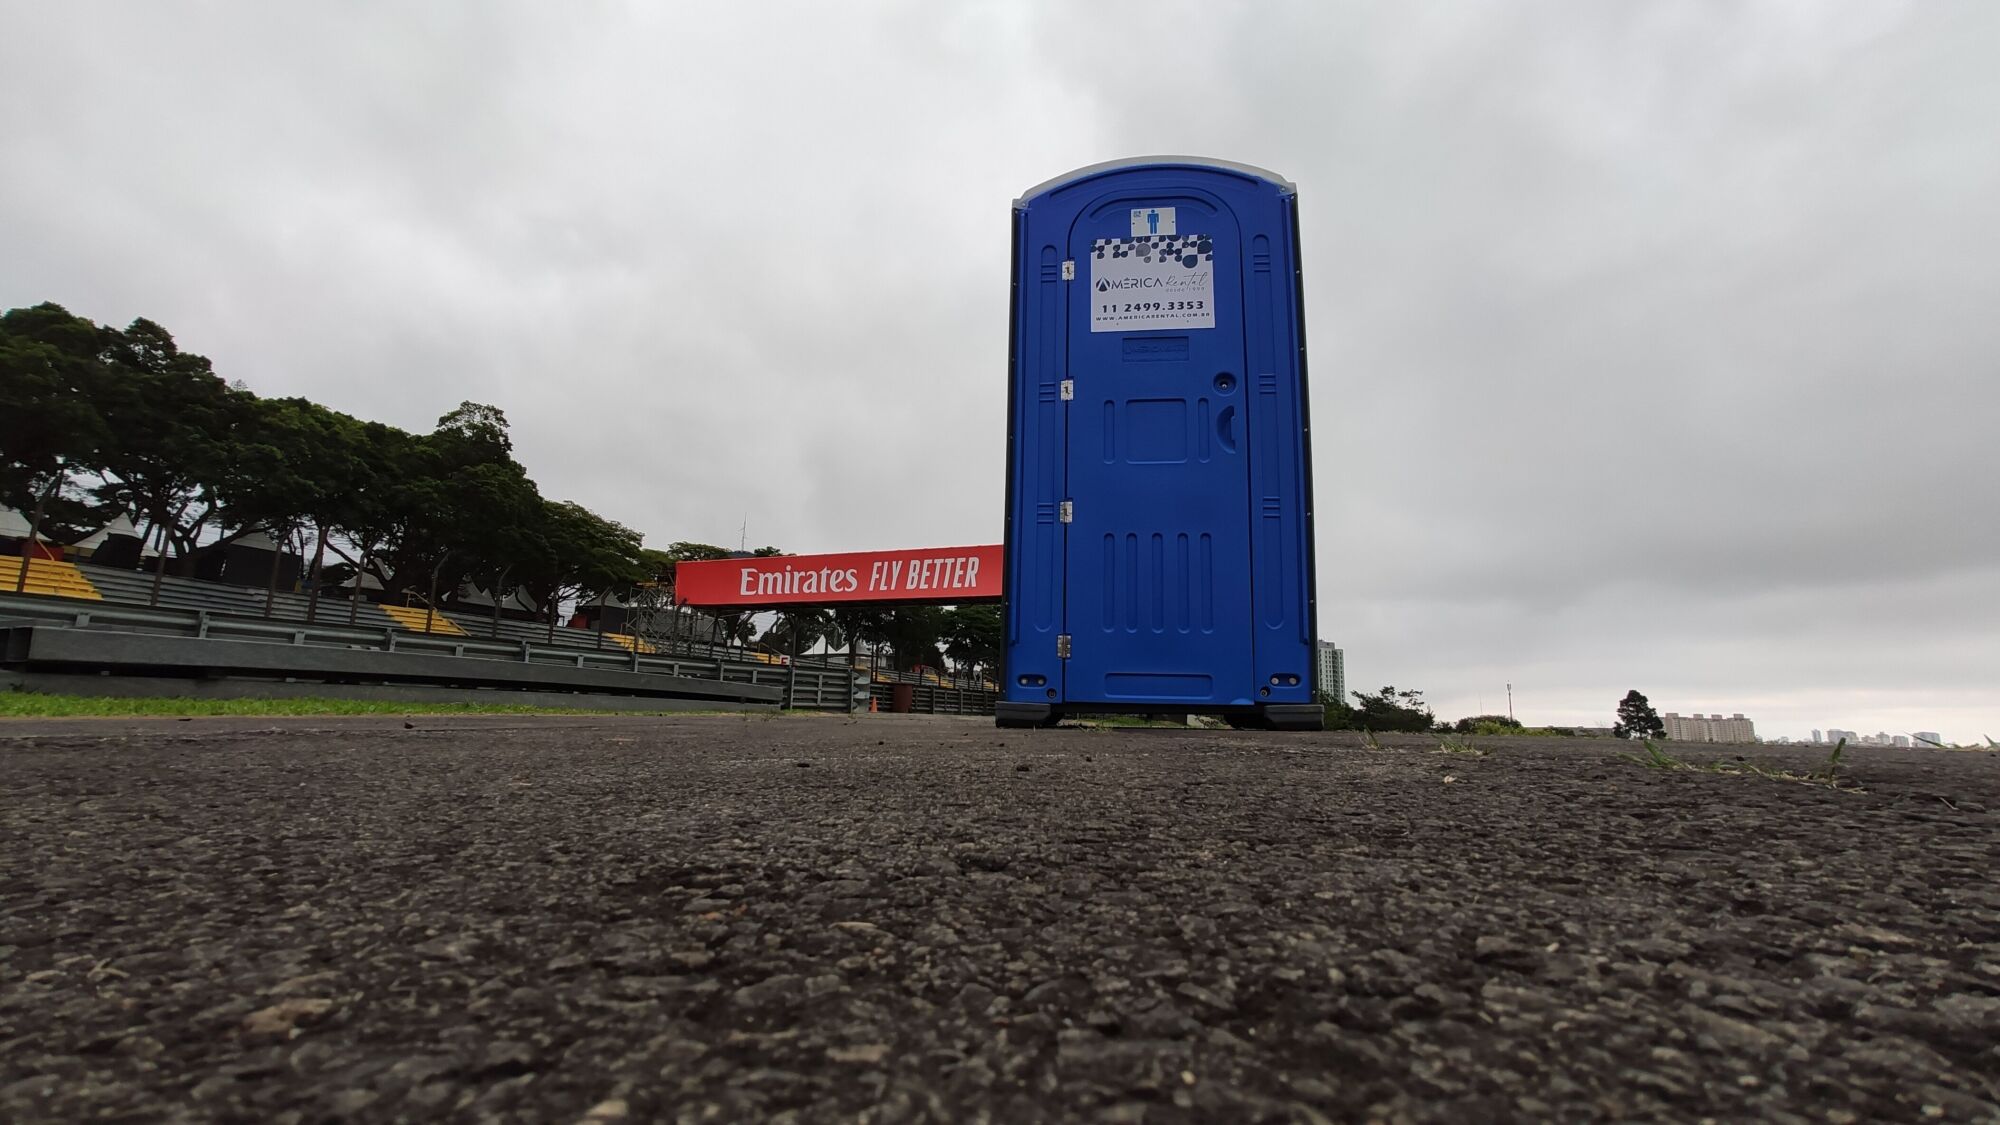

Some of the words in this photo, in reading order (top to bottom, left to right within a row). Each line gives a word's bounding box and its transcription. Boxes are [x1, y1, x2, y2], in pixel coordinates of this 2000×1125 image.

[1165, 272, 1208, 289] Rental
[1102, 304, 1117, 313] 11
[1124, 301, 1204, 312] 2499.3353
[740, 565, 858, 596] Emirates
[869, 560, 903, 592] FLY
[905, 556, 980, 590] BETTER
